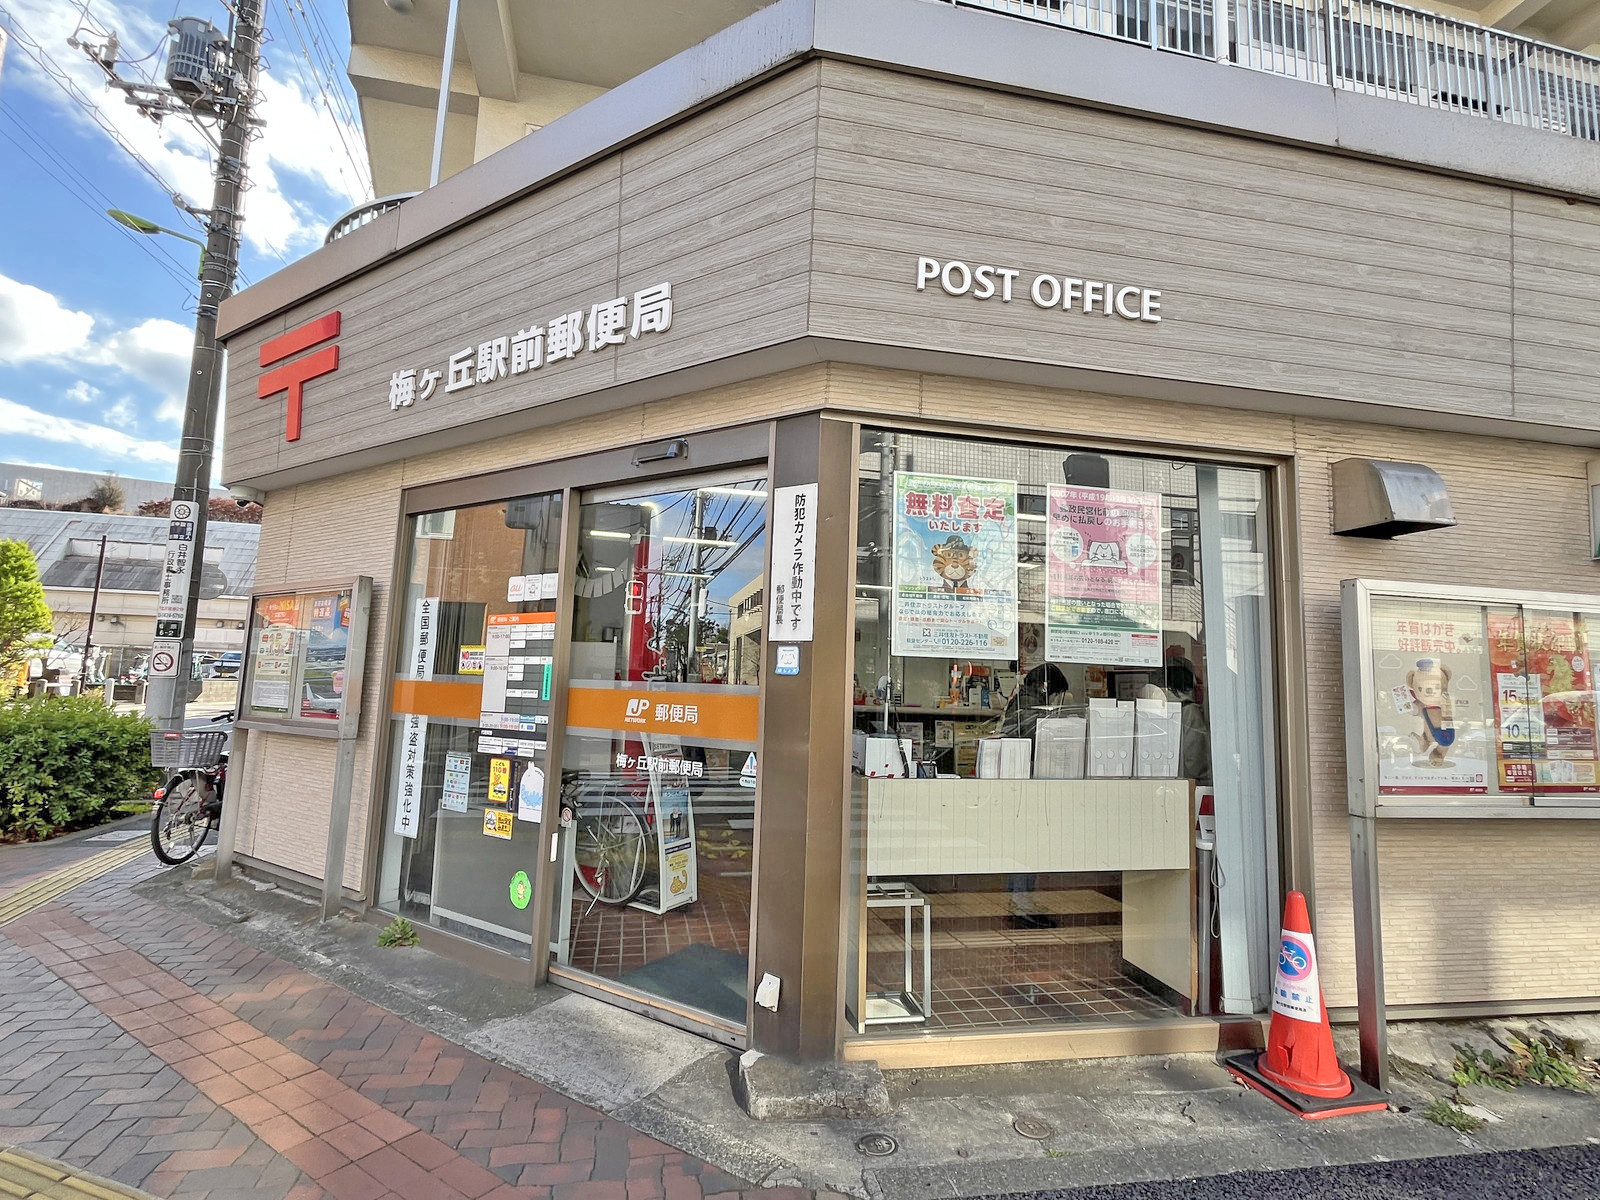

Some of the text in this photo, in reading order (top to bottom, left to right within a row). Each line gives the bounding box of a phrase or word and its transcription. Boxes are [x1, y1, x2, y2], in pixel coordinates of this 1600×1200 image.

[916, 256, 1162, 323] POST OFFICE
[904, 491, 1006, 522] 無料査定
[928, 520, 983, 533] いたします
[790, 494, 807, 632] 防犯カメラ作動中です
[775, 584, 785, 626] 郵便局長
[414, 599, 431, 681] 全国郵便局
[941, 638, 988, 647] 0120-226-116
[1396, 620, 1455, 637] 年賀はがき
[625, 698, 699, 725] JP 郵便局
